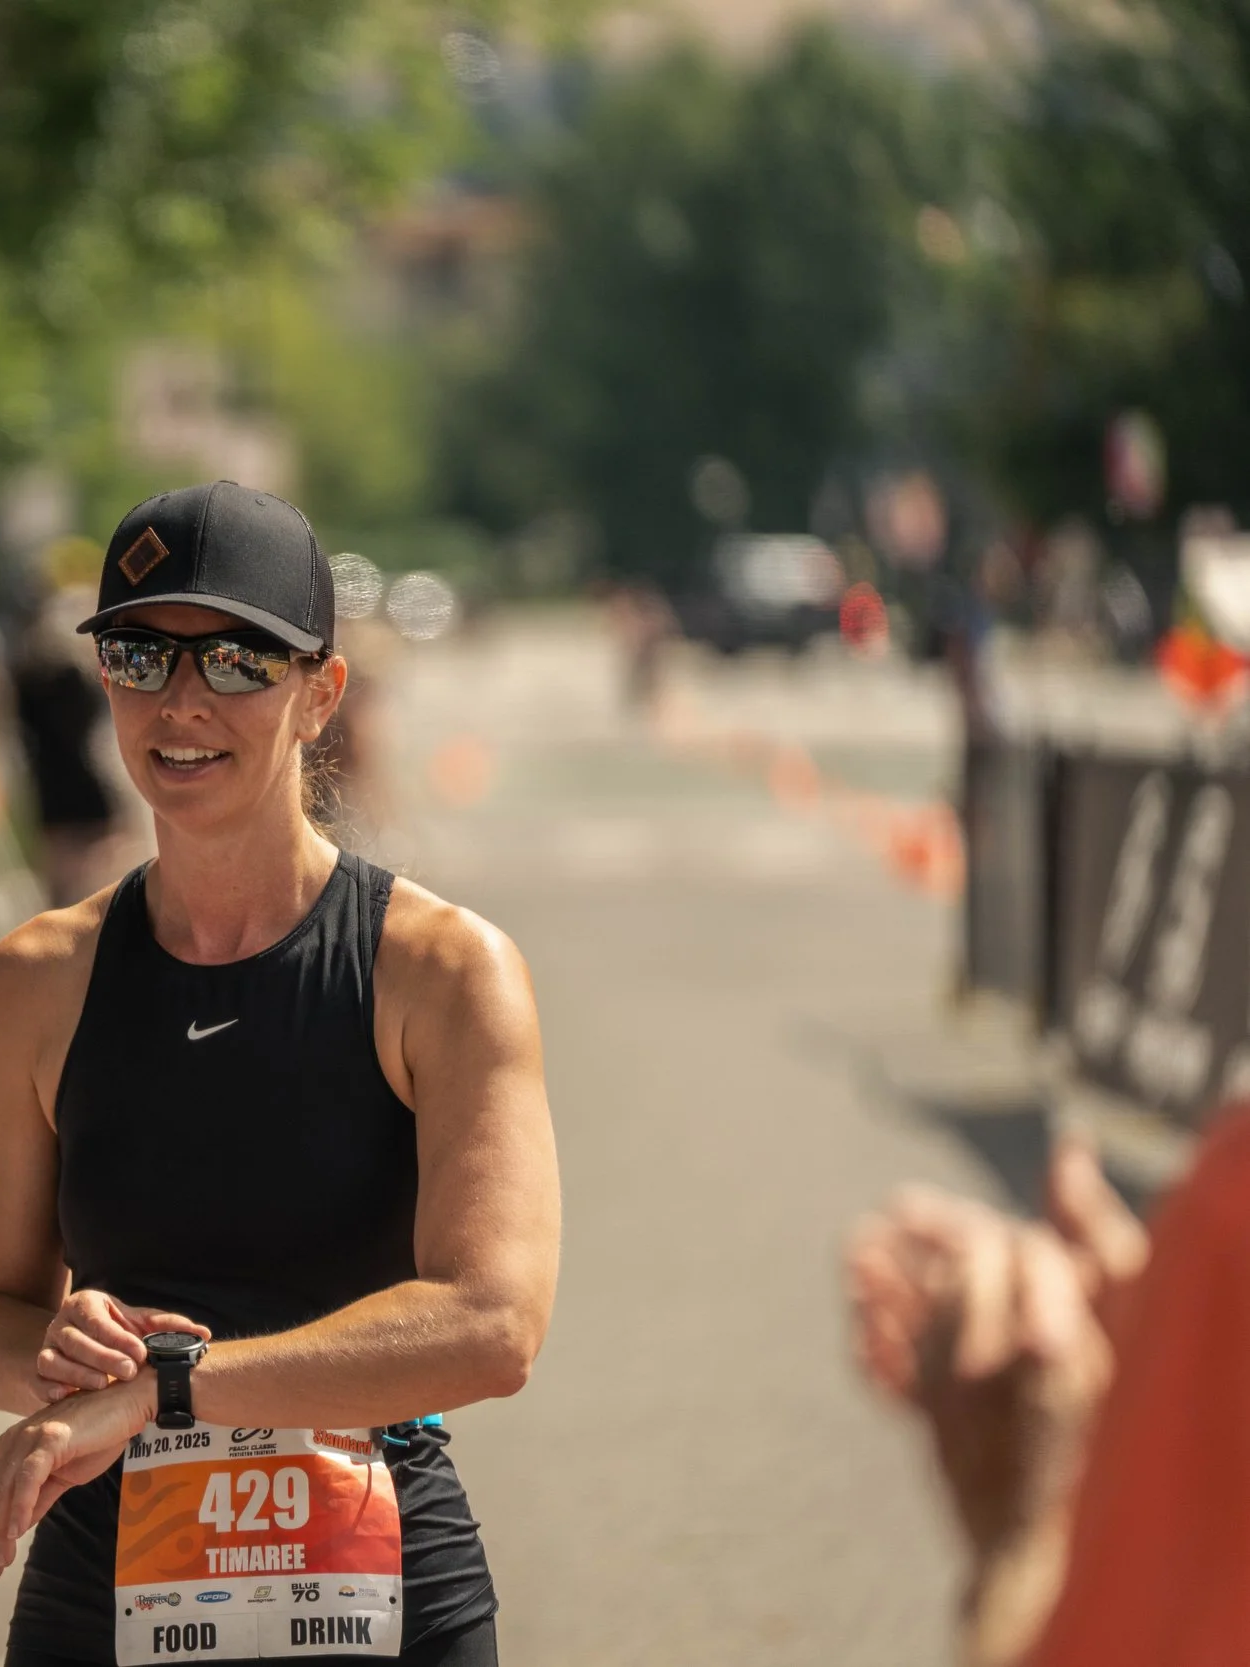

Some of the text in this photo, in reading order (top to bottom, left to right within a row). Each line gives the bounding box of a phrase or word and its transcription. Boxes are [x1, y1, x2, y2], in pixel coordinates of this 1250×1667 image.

[128, 1432, 210, 1459] July 20, 2025
[251, 1443, 277, 1451] CLASSIC
[313, 1428, 372, 1456] Standard
[198, 1467, 309, 1532] 429
[206, 1544, 306, 1573] TIMAREE
[291, 1582, 320, 1590] BLUE
[292, 1590, 320, 1603] 70
[153, 1622, 217, 1653] FOOD
[290, 1616, 372, 1645] DRINK
